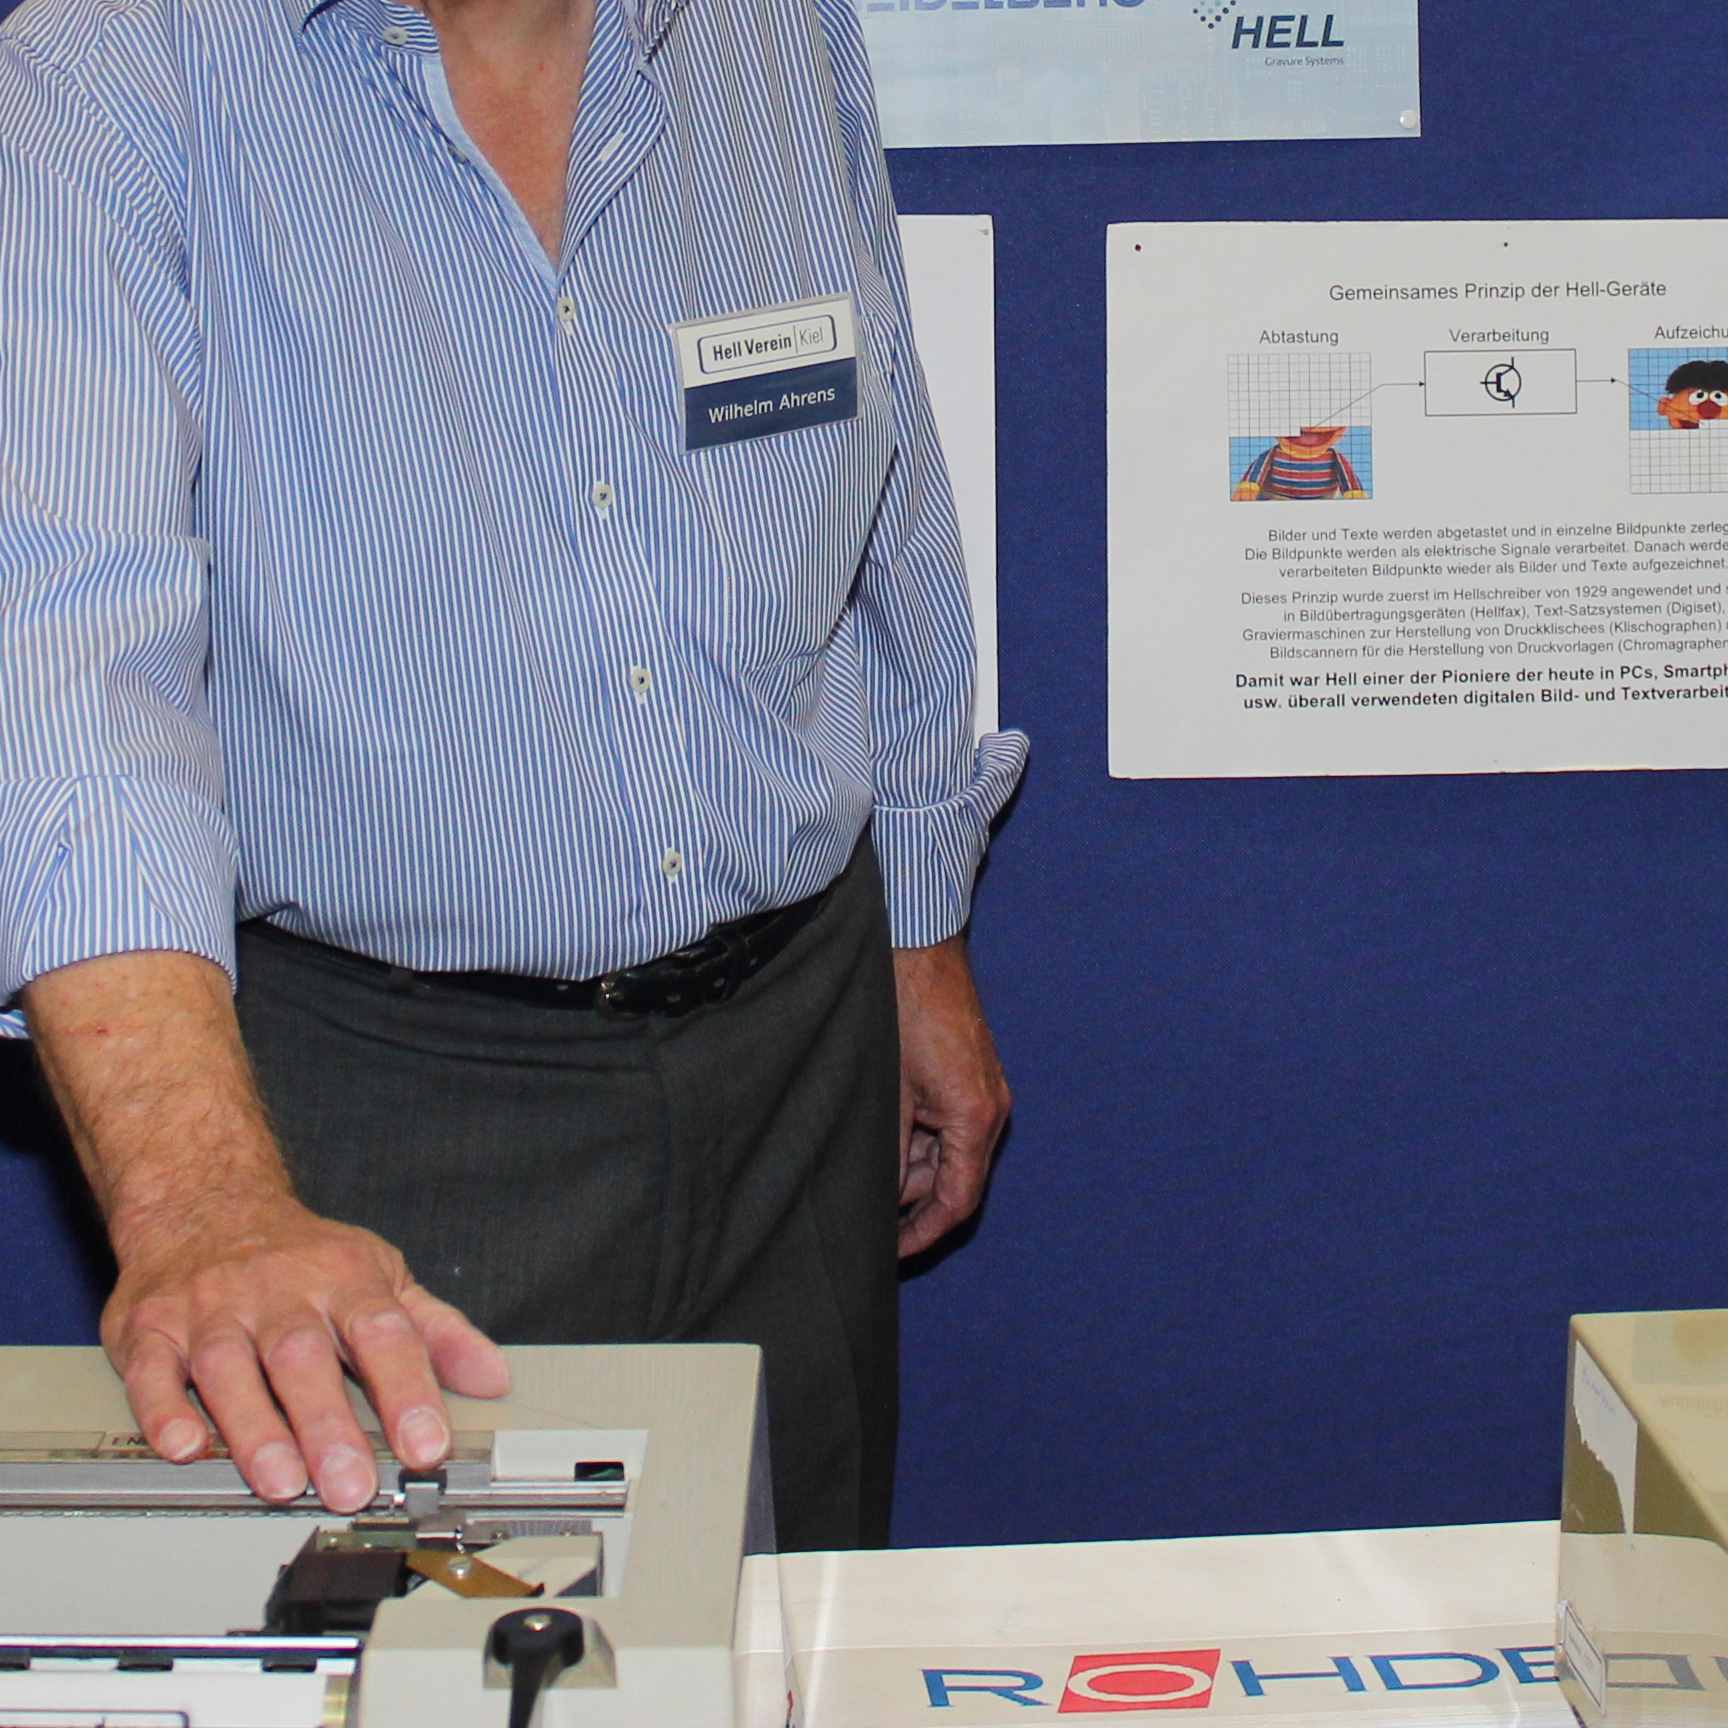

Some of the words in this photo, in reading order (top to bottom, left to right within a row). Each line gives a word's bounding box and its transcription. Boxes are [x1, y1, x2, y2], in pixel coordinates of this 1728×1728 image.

[1232, 14, 1344, 49] HELL
[1265, 57, 1303, 66] Gravure
[1305, 56, 1344, 66] Systems
[1329, 284, 1458, 301] Gemeinsames
[1464, 283, 1525, 300] Prinzip
[1531, 282, 1560, 297] der
[1566, 280, 1666, 296] Hell-Geräte
[714, 341, 742, 361] Hell
[745, 335, 792, 358] Verein
[799, 328, 824, 346] Kiel
[1259, 330, 1339, 346] Abtastung
[1448, 327, 1550, 344] Verarbeitung
[709, 400, 772, 423] Wilhelm
[780, 388, 835, 410] Ahrens
[1268, 529, 1306, 542] Bilder
[1312, 529, 1336, 541] und
[1343, 528, 1378, 541] Texte
[1383, 527, 1432, 540] werden
[1437, 526, 1507, 541] abgetastet
[1512, 526, 1536, 537] und
[1541, 524, 1551, 536] in
[1557, 523, 1612, 536] einzelne
[1617, 521, 1686, 536] Bildpunkte
[1245, 548, 1267, 560] Die
[1272, 547, 1343, 561] Bildpunkte
[1347, 546, 1396, 559] werden
[1401, 546, 1420, 558] als
[1424, 544, 1496, 558] elektrische
[1501, 543, 1551, 558] Signale
[1555, 542, 1628, 555] verarbeitet.
[1634, 540, 1685, 553] Danach
[1279, 566, 1367, 578] verarbeiteten
[1372, 564, 1442, 578] Bildpunkte
[1447, 564, 1491, 575] wieder
[1497, 562, 1514, 573] als
[1520, 560, 1558, 573] Bilder
[1562, 560, 1586, 572] und
[1592, 559, 1627, 571] Texte
[1632, 557, 1728, 573] aufgezeichnet.
[1241, 592, 1287, 604] Dieses
[1292, 591, 1338, 606] Prinzip
[1343, 590, 1383, 603] wurde
[1389, 589, 1429, 602] zuerst
[1434, 589, 1449, 601] im
[1453, 586, 1541, 601] Hellschreiber
[1546, 588, 1569, 599] von
[1575, 585, 1607, 598] 1929
[1611, 584, 1692, 599] angewendet
[1697, 583, 1721, 595] und
[1236, 673, 1284, 688] Damit
[1290, 674, 1319, 687] war
[1326, 672, 1357, 687] Hell
[1363, 672, 1404, 686] einer
[1410, 671, 1436, 685] der
[1442, 669, 1510, 684] Pioniere
[1516, 668, 1543, 682] der
[1548, 667, 1594, 681] heute
[1600, 666, 1614, 680] in
[1620, 666, 1658, 681] PCs,
[1244, 696, 1281, 709] usw.
[1288, 693, 1345, 709] überall
[1351, 691, 1458, 707] verwendeten
[1463, 689, 1535, 707] digitalen
[1541, 688, 1579, 703] Bild-
[1585, 687, 1615, 701] und
[922, 1645, 1558, 1713] ROHDE
